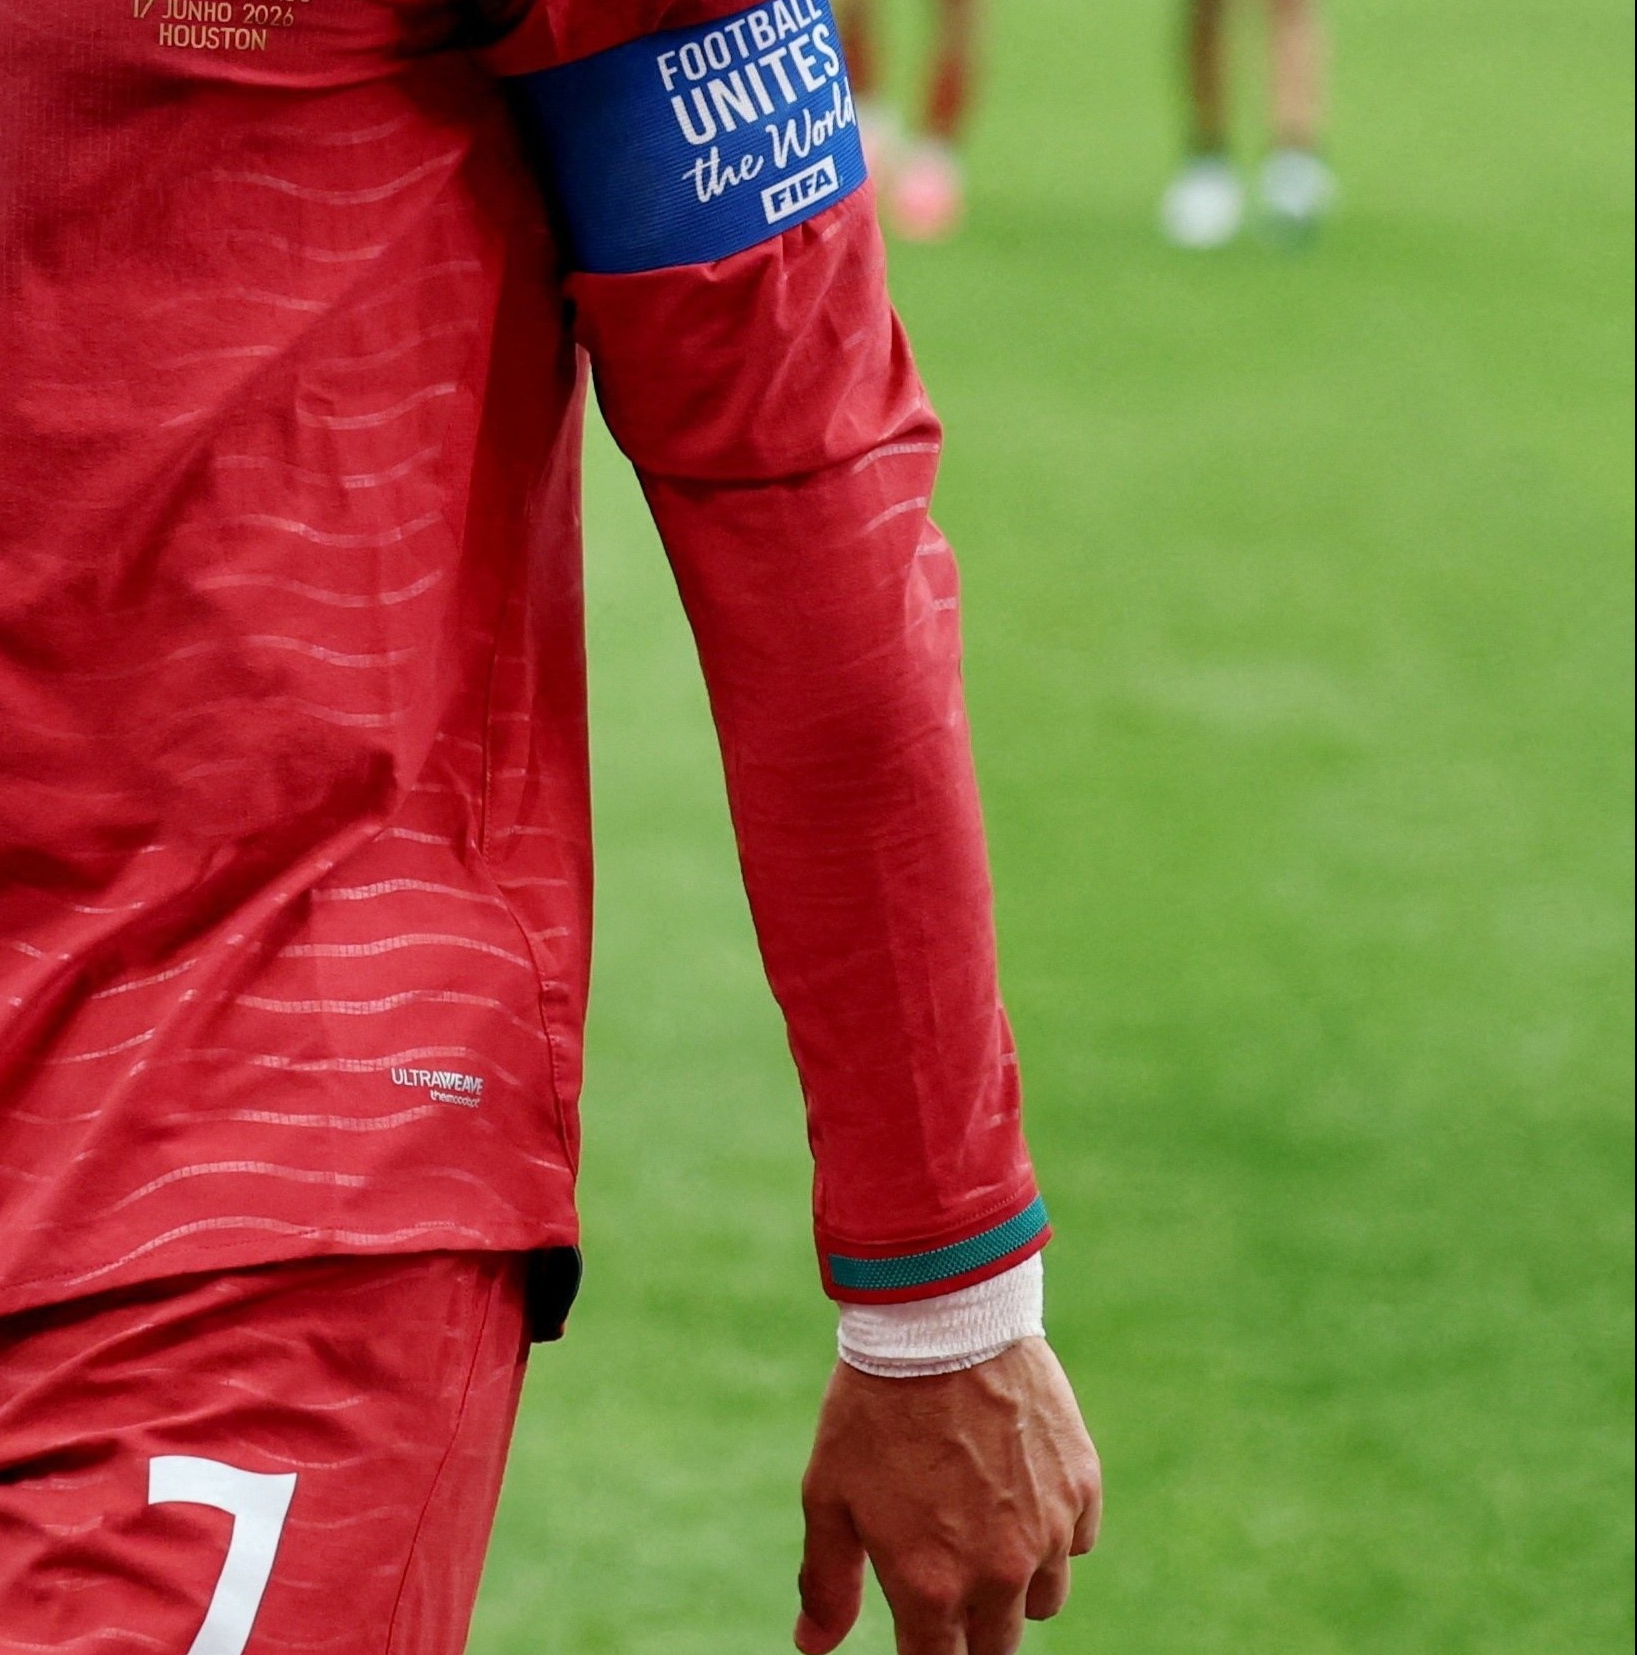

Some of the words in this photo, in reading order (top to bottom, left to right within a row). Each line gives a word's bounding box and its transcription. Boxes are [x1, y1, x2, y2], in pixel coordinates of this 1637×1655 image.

[158, 23, 268, 51] HOUSTON
[242, 3, 295, 27] 2026
[671, 23, 840, 146] UNITES
[681, 146, 764, 203] the
[765, 76, 857, 169] World
[770, 167, 833, 214] FIFA
[390, 1067, 484, 1096] ULTRAWEAVE
[147, 1454, 298, 1655] 7
